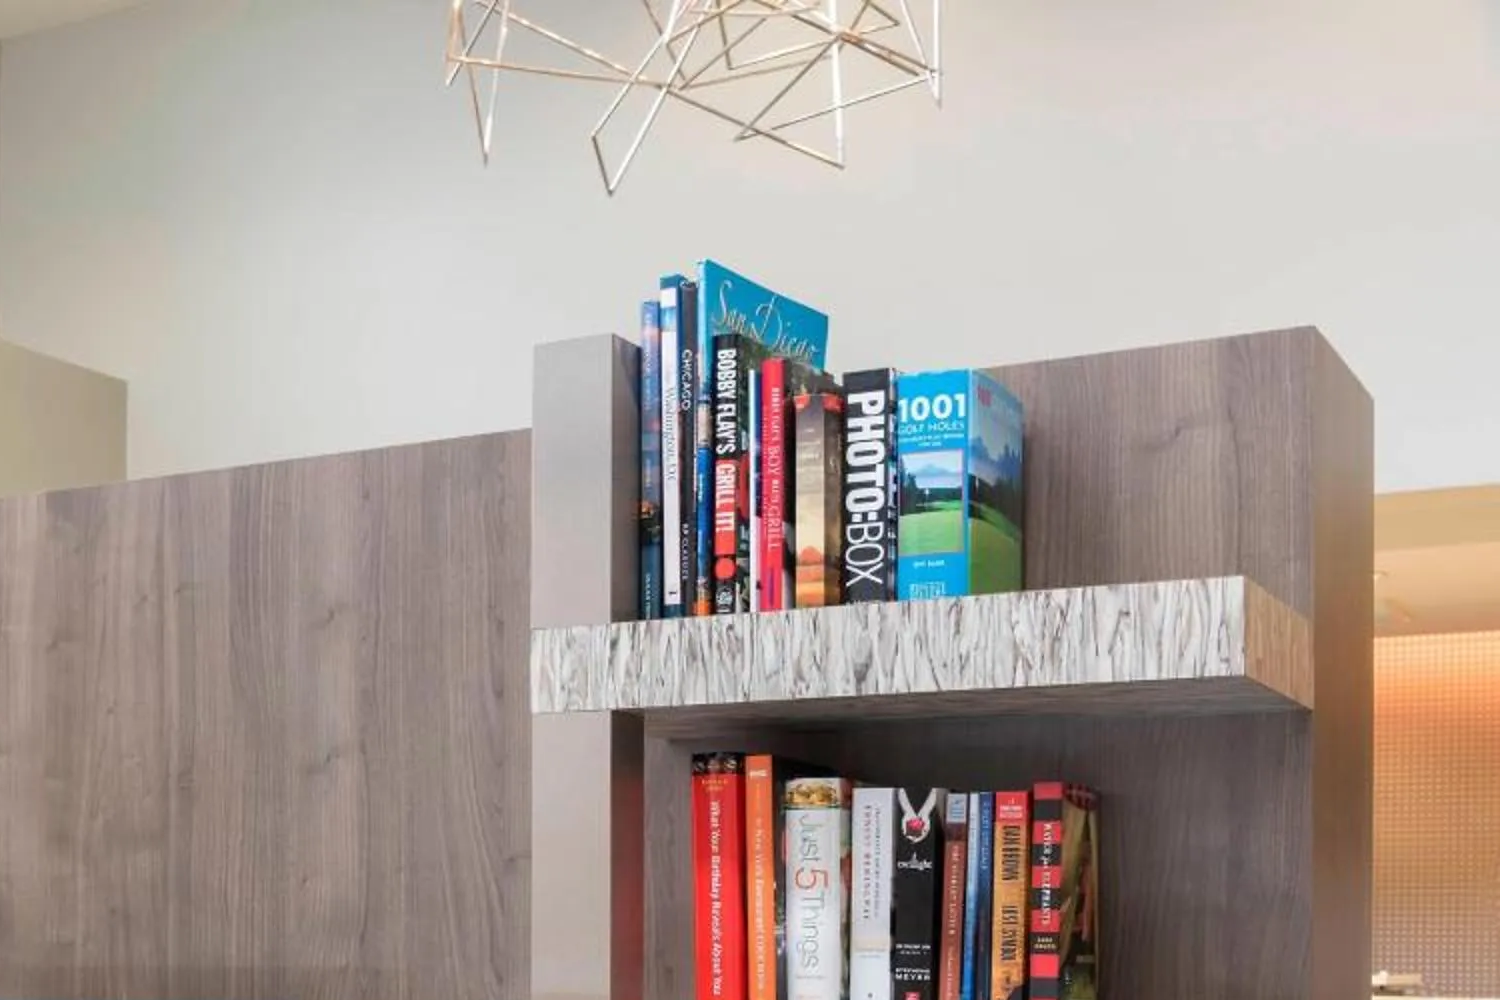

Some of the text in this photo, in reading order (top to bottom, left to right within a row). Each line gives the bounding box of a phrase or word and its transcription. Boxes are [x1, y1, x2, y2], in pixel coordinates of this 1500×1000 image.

[681, 348, 693, 411] CHICAGO
[717, 348, 737, 454] BOBBY FLAY'S
[898, 394, 966, 422] 1001
[898, 421, 964, 435] GOLF HOLES
[768, 445, 781, 475] BOY
[716, 463, 736, 533] GRILL IT!
[768, 505, 781, 550] GRILL
[799, 814, 823, 861] Just
[710, 855, 722, 898] Birthday
[795, 868, 828, 889] 5
[1002, 847, 1020, 881] BROWN
[797, 891, 825, 968] Things
